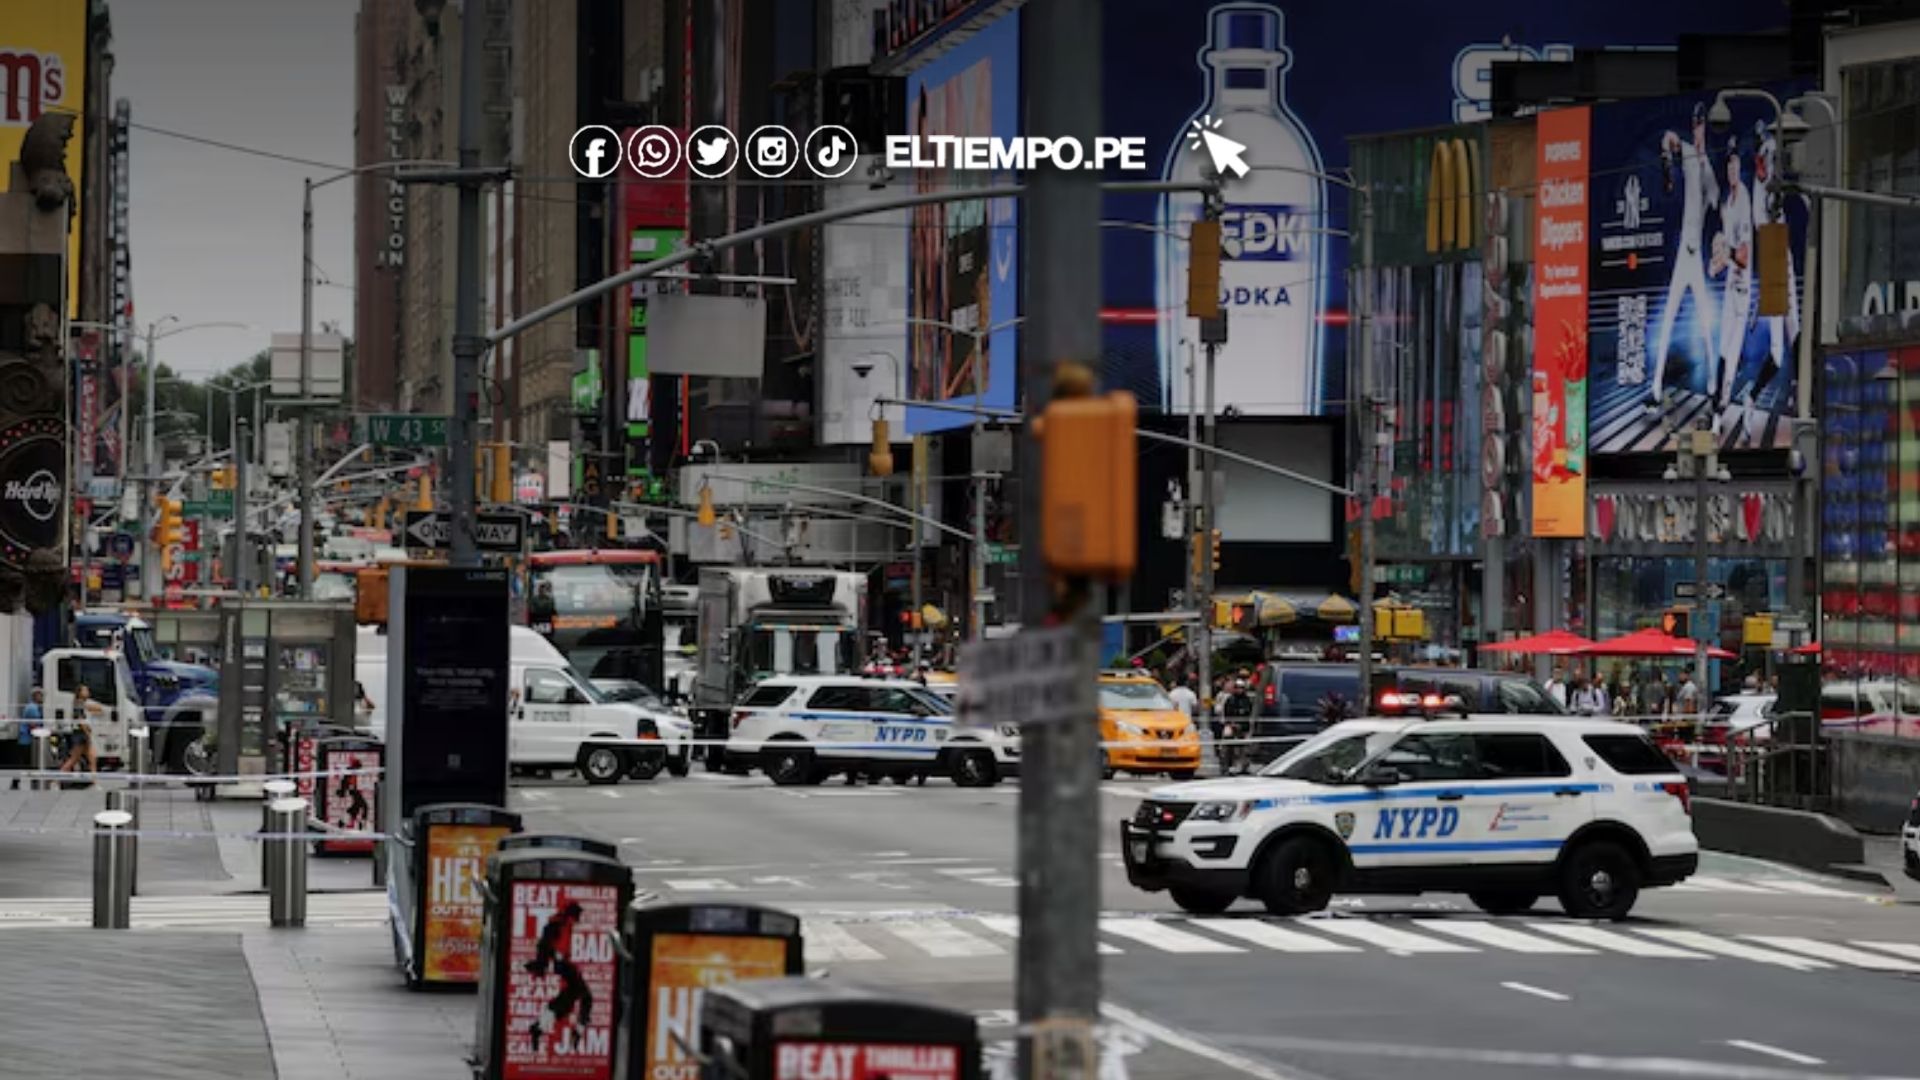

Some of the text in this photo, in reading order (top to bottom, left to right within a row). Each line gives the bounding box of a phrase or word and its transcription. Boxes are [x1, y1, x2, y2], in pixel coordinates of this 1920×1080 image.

[385, 85, 408, 266] WELLINGTON
[1540, 178, 1585, 209] Chicken
[1540, 217, 1584, 251] Dippers
[1218, 287, 1291, 306] ODKA
[371, 419, 391, 441] W
[399, 419, 423, 441] 43
[477, 524, 514, 539] WAY
[874, 725, 927, 742] NYPD
[1374, 805, 1460, 840] NYPD
[513, 884, 560, 905] BEAT
[512, 906, 557, 938] IT
[570, 932, 614, 963] BAD
[777, 1042, 957, 1080] BEAT THRILLER
